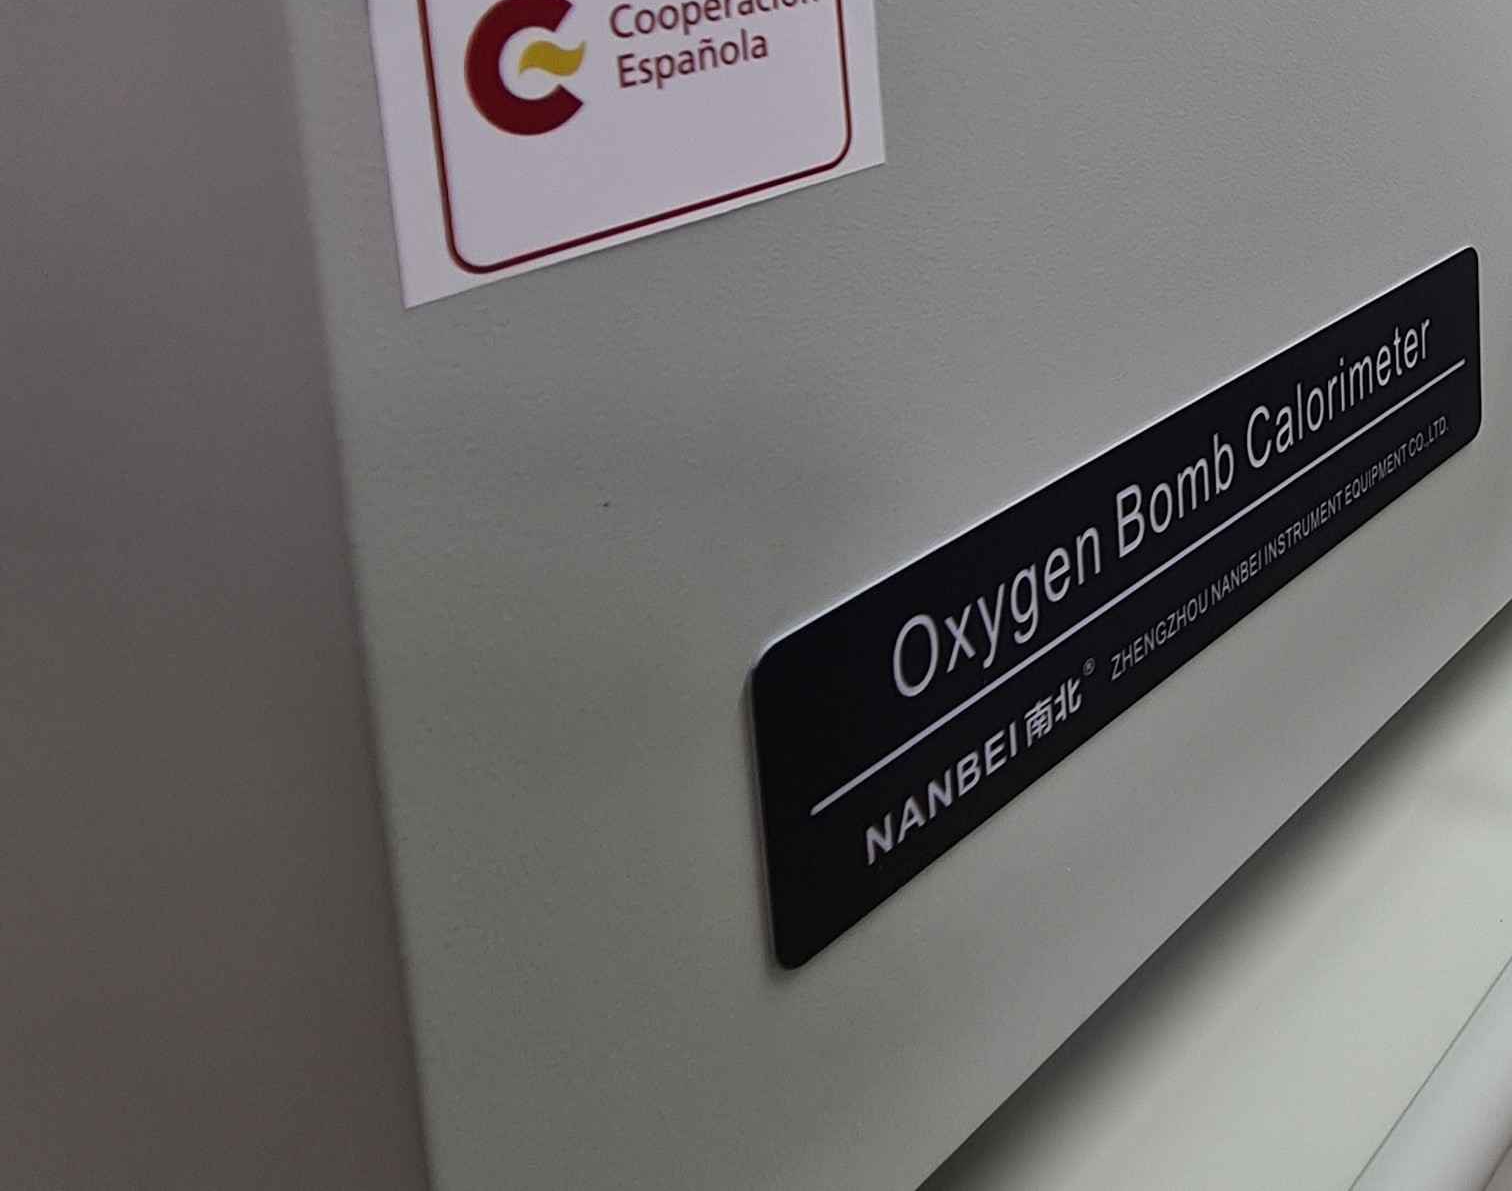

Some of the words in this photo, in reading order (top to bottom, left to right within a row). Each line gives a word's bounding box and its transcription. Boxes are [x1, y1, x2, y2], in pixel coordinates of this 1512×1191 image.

[617, 28, 769, 89] Española
[893, 526, 1101, 697] Oxygen
[1116, 433, 1235, 558] Bomb
[1246, 318, 1431, 468] Calorimeter
[1110, 588, 1209, 681] ZHENGZHOU
[1211, 549, 1263, 606] NANBEI
[1264, 490, 1345, 565] INSTRUMENT
[1344, 443, 1408, 505] EQUIPMENT
[865, 721, 1017, 866] NANBEI
